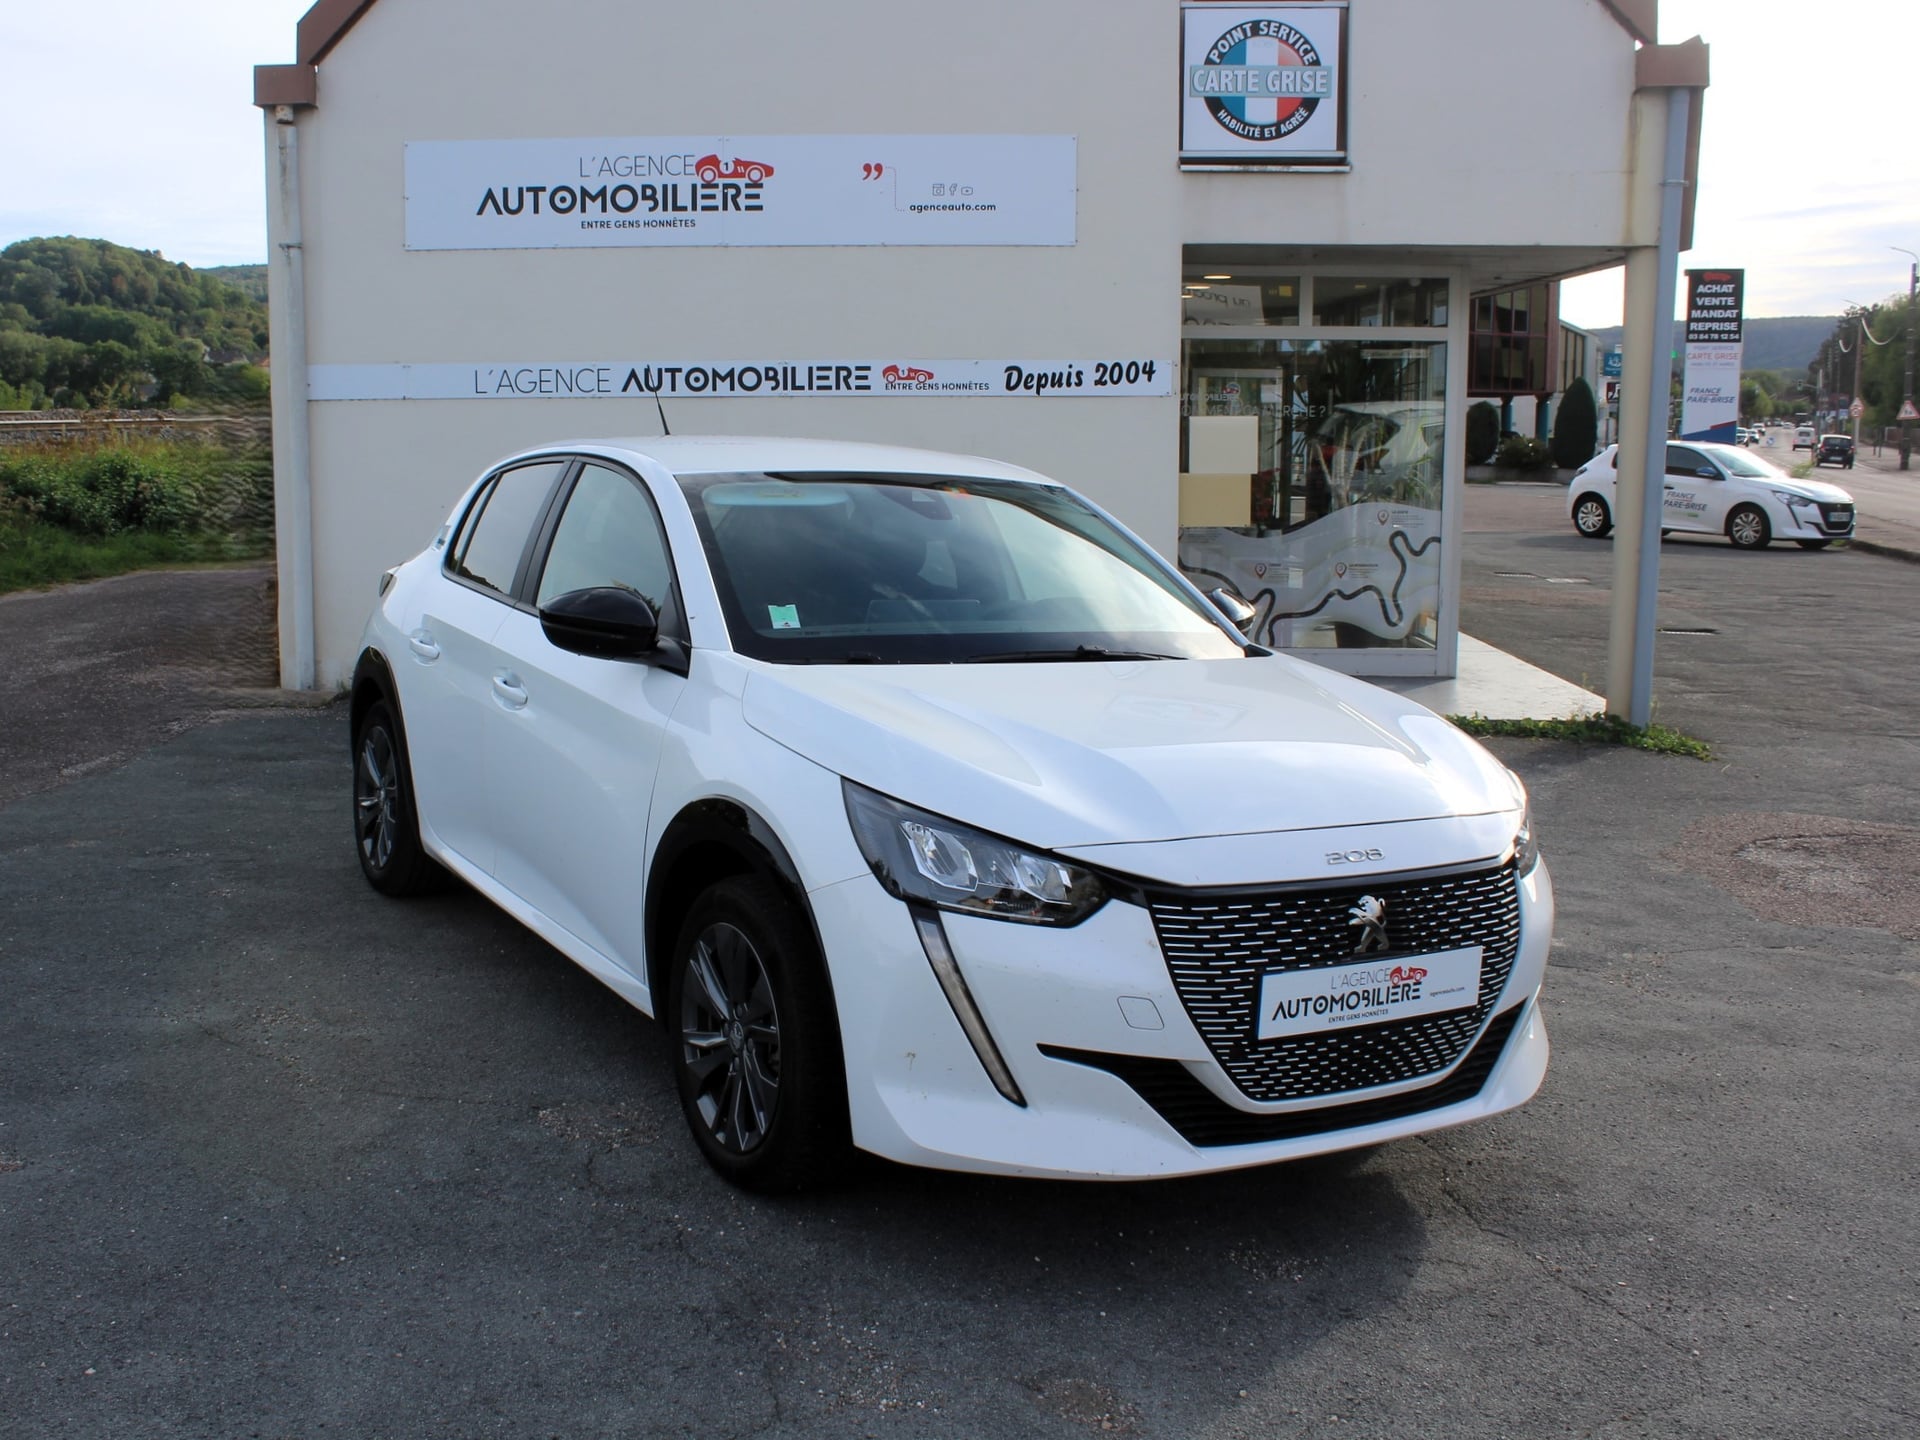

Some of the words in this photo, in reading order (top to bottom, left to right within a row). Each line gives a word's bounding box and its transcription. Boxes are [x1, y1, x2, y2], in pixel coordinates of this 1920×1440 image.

[1209, 23, 1253, 64] POINT
[1259, 21, 1316, 65] SERVICE
[1193, 69, 1259, 93] CARTE
[1266, 70, 1328, 94] GRISE
[1217, 109, 1261, 138] HABILITÉ
[1264, 127, 1277, 138] ET
[579, 154, 696, 178] L'AGENCE
[909, 202, 996, 214] agenceauto.com
[581, 220, 612, 229] ENTRE
[614, 220, 641, 229] GENS
[643, 217, 696, 228] HONNÊTES
[1697, 284, 1735, 293] ACHAT
[1696, 297, 1736, 306] VENTE
[1691, 310, 1740, 318] MANDAT
[1690, 322, 1739, 331] REPRISE
[1687, 352, 1712, 360] CARTE
[1714, 352, 1740, 360] GRISE
[474, 368, 612, 394] L'AGENCE
[1004, 364, 1083, 396] Depuis
[1094, 360, 1156, 387] 2004
[885, 382, 914, 391] ENTRE
[916, 382, 940, 391] GENS
[942, 380, 989, 391] HONNÊTES
[1686, 396, 1736, 404] PARE-BRISE
[1667, 491, 1696, 499] FRANCE
[1664, 499, 1707, 511] PARE-BRISE
[1325, 849, 1385, 865] 208
[1331, 968, 1391, 989] L'AGENCE
[1328, 1015, 1346, 1023] ENTRE
[1346, 1012, 1361, 1021] GENS
